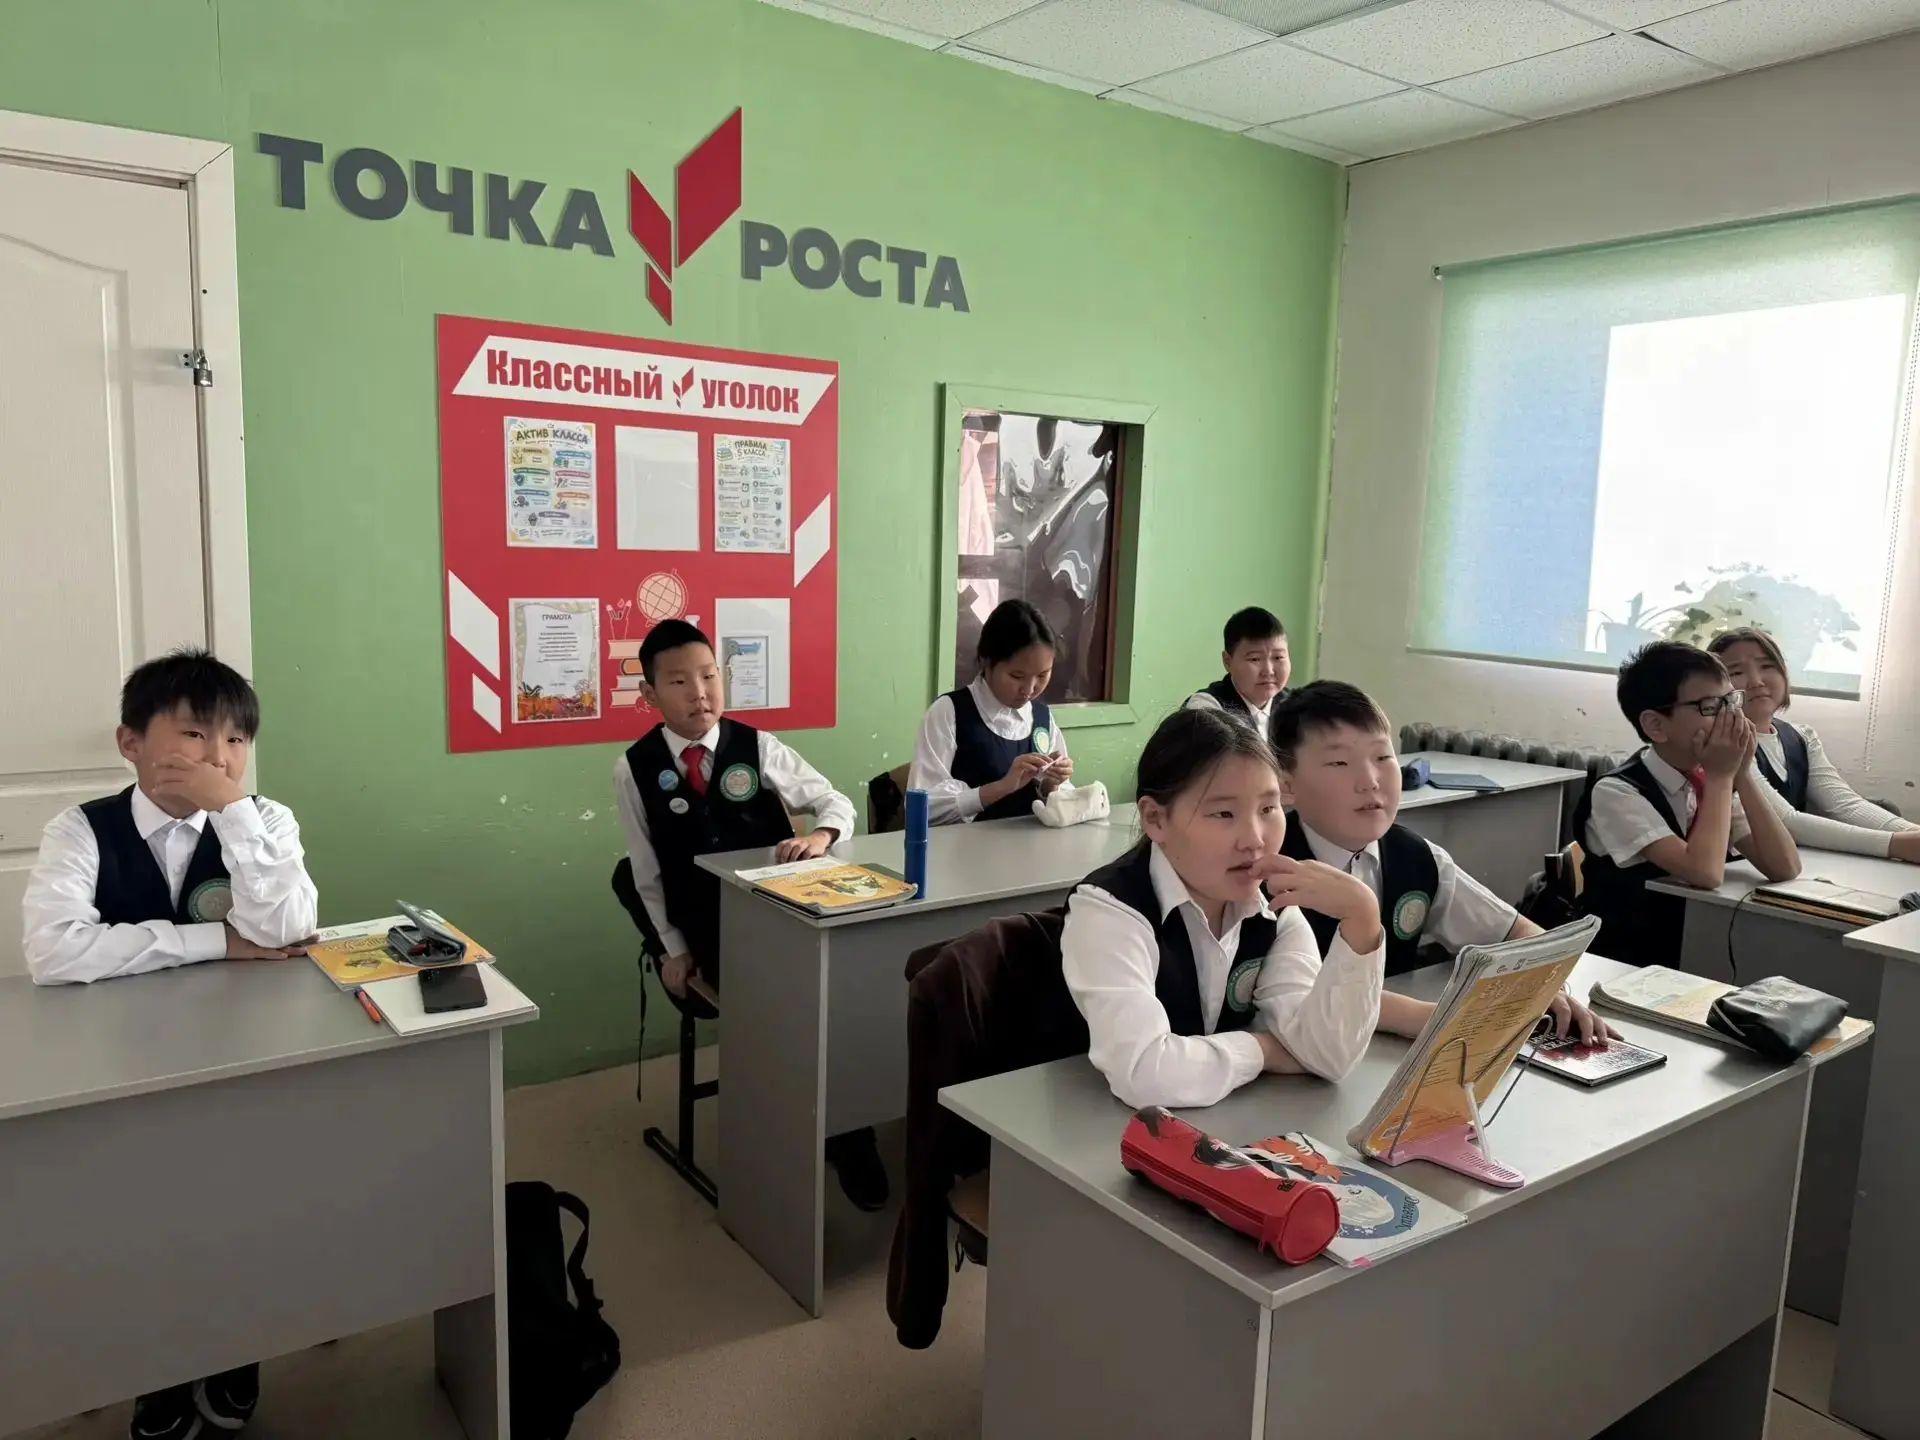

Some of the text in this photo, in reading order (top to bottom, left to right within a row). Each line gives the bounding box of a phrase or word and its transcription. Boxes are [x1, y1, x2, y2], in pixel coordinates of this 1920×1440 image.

[257, 132, 970, 313] ТОЧКА РОСТА
[487, 349, 800, 414] Классный уголок
[517, 428, 549, 441] АКТИВ
[552, 429, 588, 444] КЛАССА
[734, 440, 767, 451] ПРАВИЛА
[737, 448, 766, 457] 5 КЛАССА
[542, 613, 573, 621] ГРАМОТА
